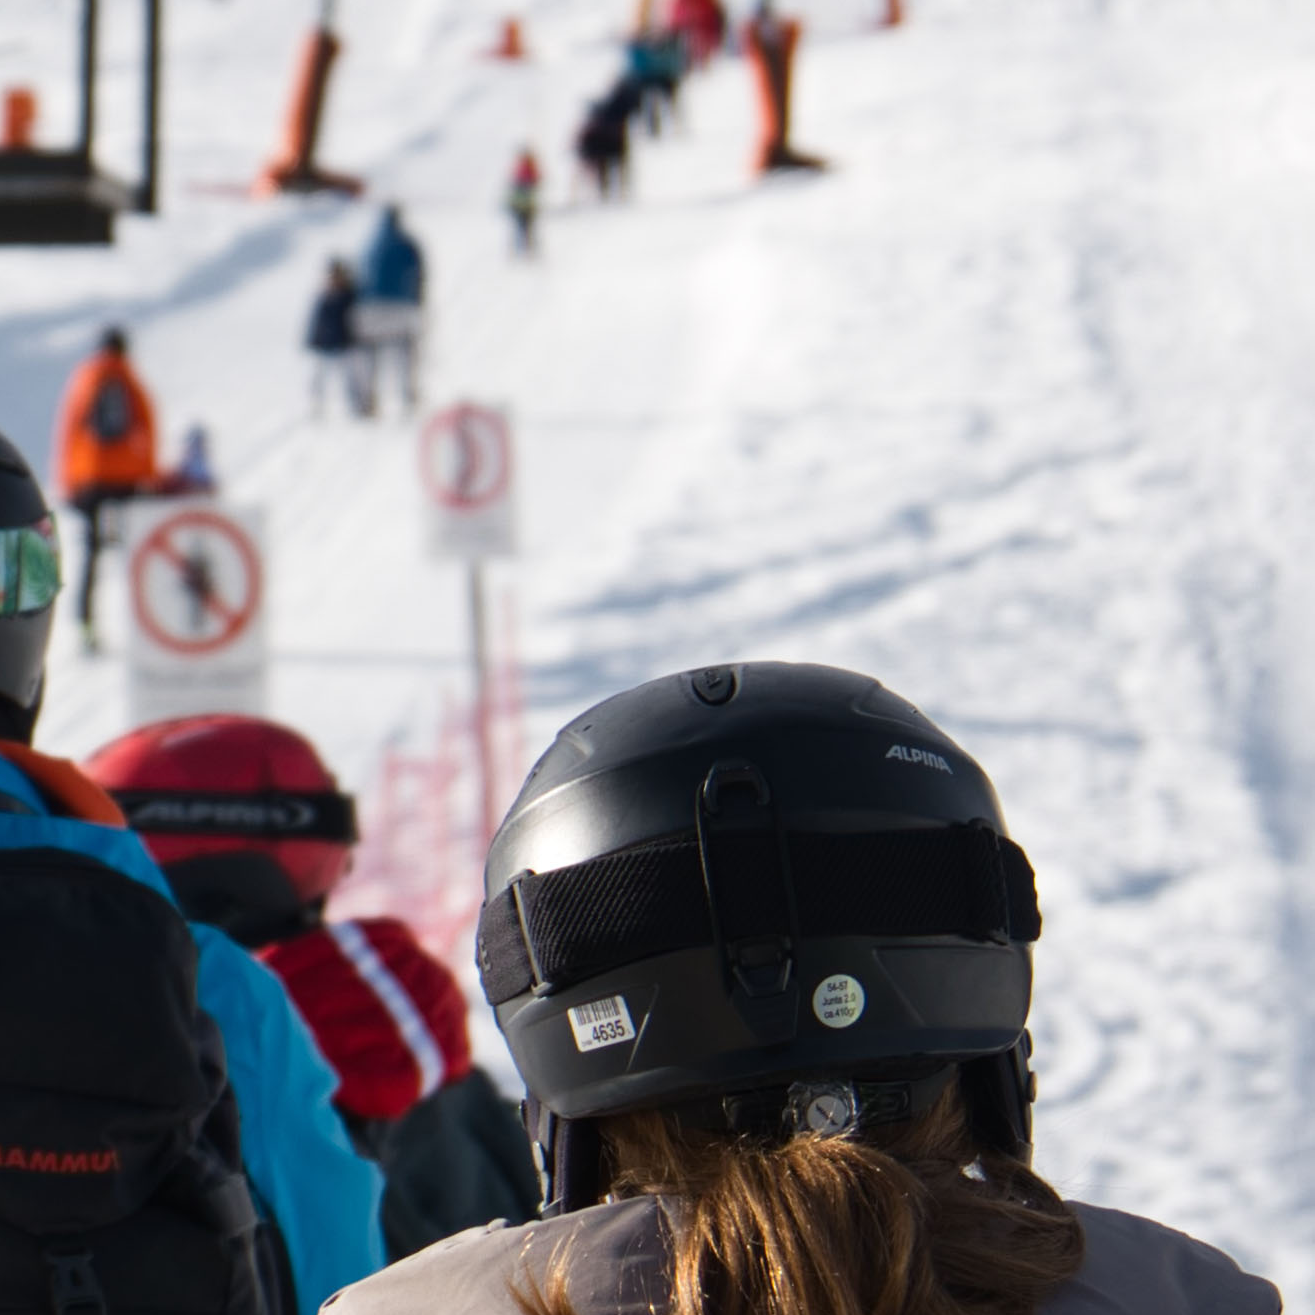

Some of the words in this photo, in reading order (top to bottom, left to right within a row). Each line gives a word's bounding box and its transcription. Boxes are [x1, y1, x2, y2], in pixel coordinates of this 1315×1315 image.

[885, 744, 954, 775] ALPINA
[827, 980, 848, 992] 54-57
[592, 1019, 625, 1043] 4635
